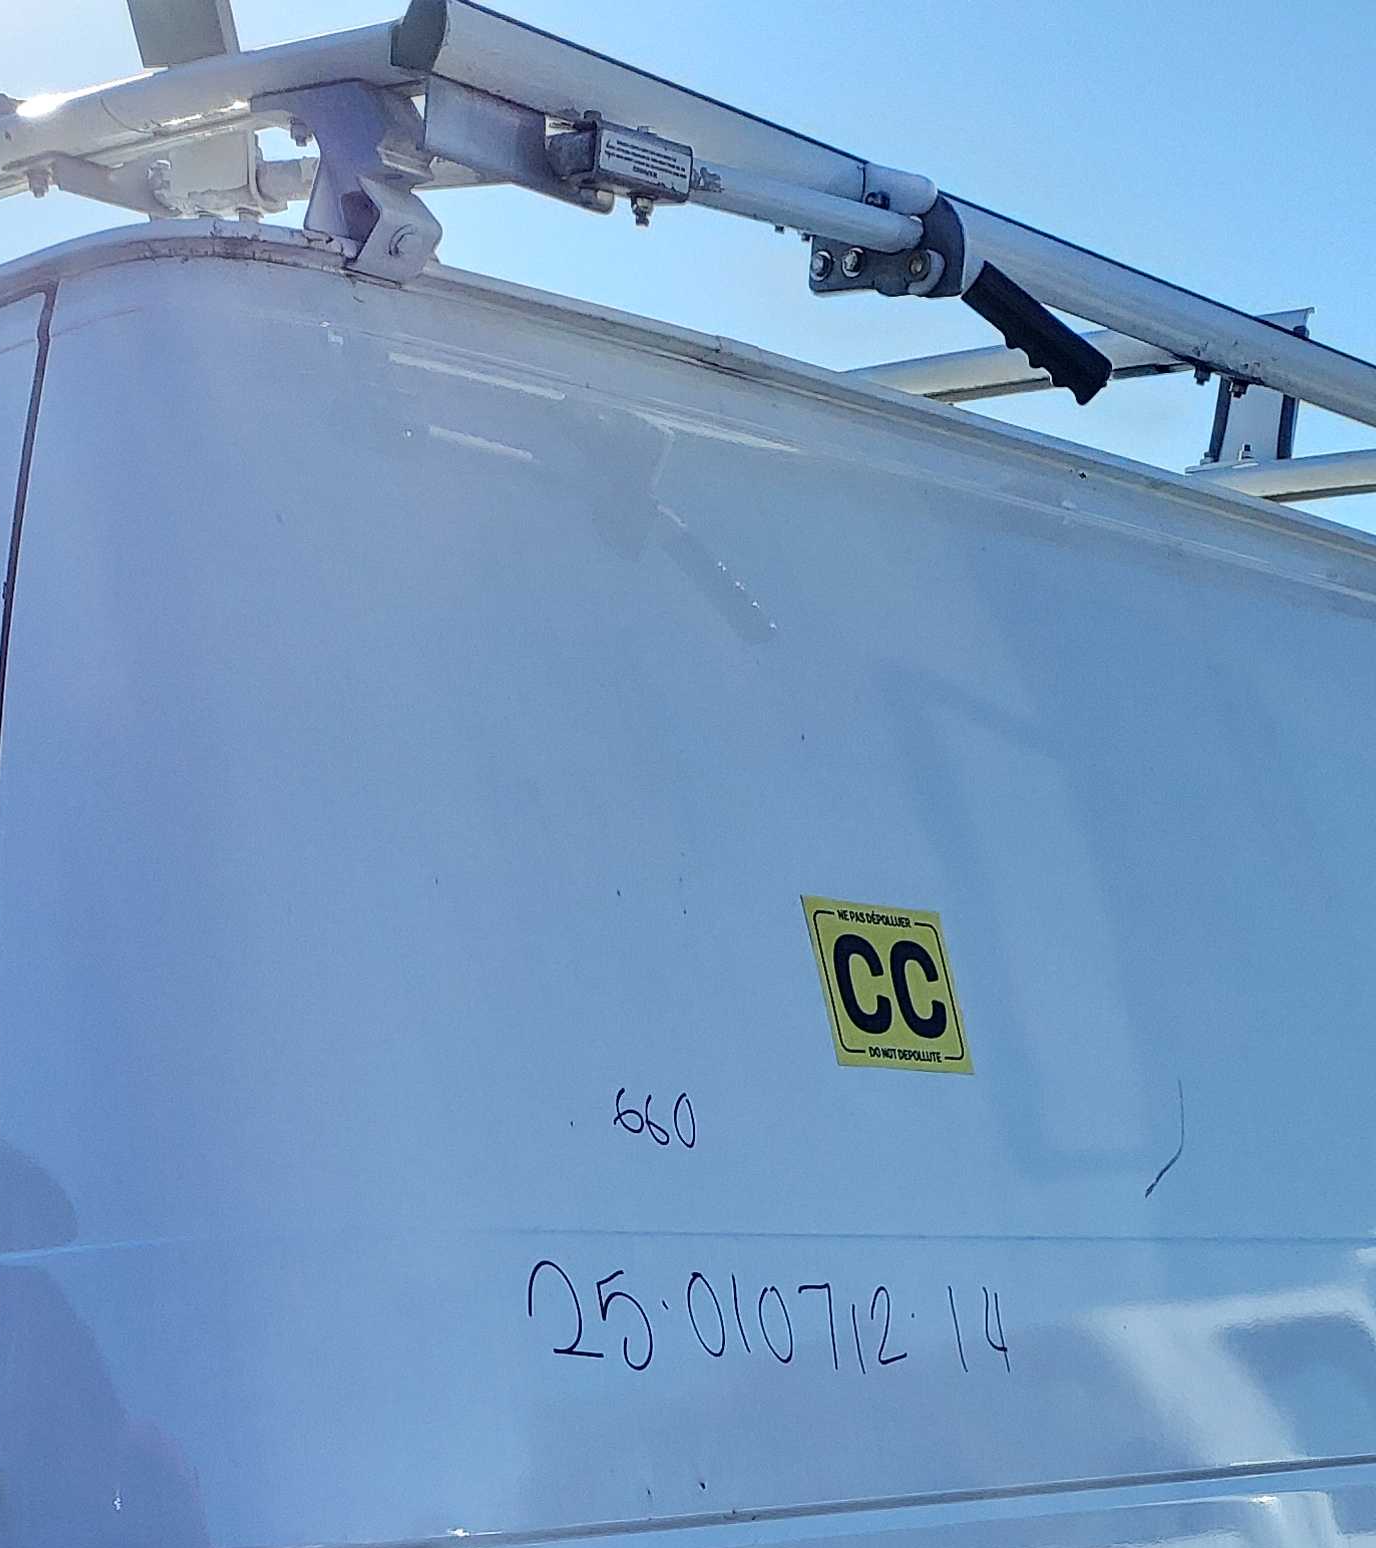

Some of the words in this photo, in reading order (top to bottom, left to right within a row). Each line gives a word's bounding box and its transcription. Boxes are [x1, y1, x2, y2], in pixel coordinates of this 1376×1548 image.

[836, 909, 850, 921] NE
[850, 910, 866, 923] PAS
[833, 933, 948, 1039] CC
[868, 1046, 881, 1058] DO
[881, 1047, 897, 1060] NOT
[897, 1049, 942, 1063] DEPOLLUTE
[613, 1087, 697, 1149] 660
